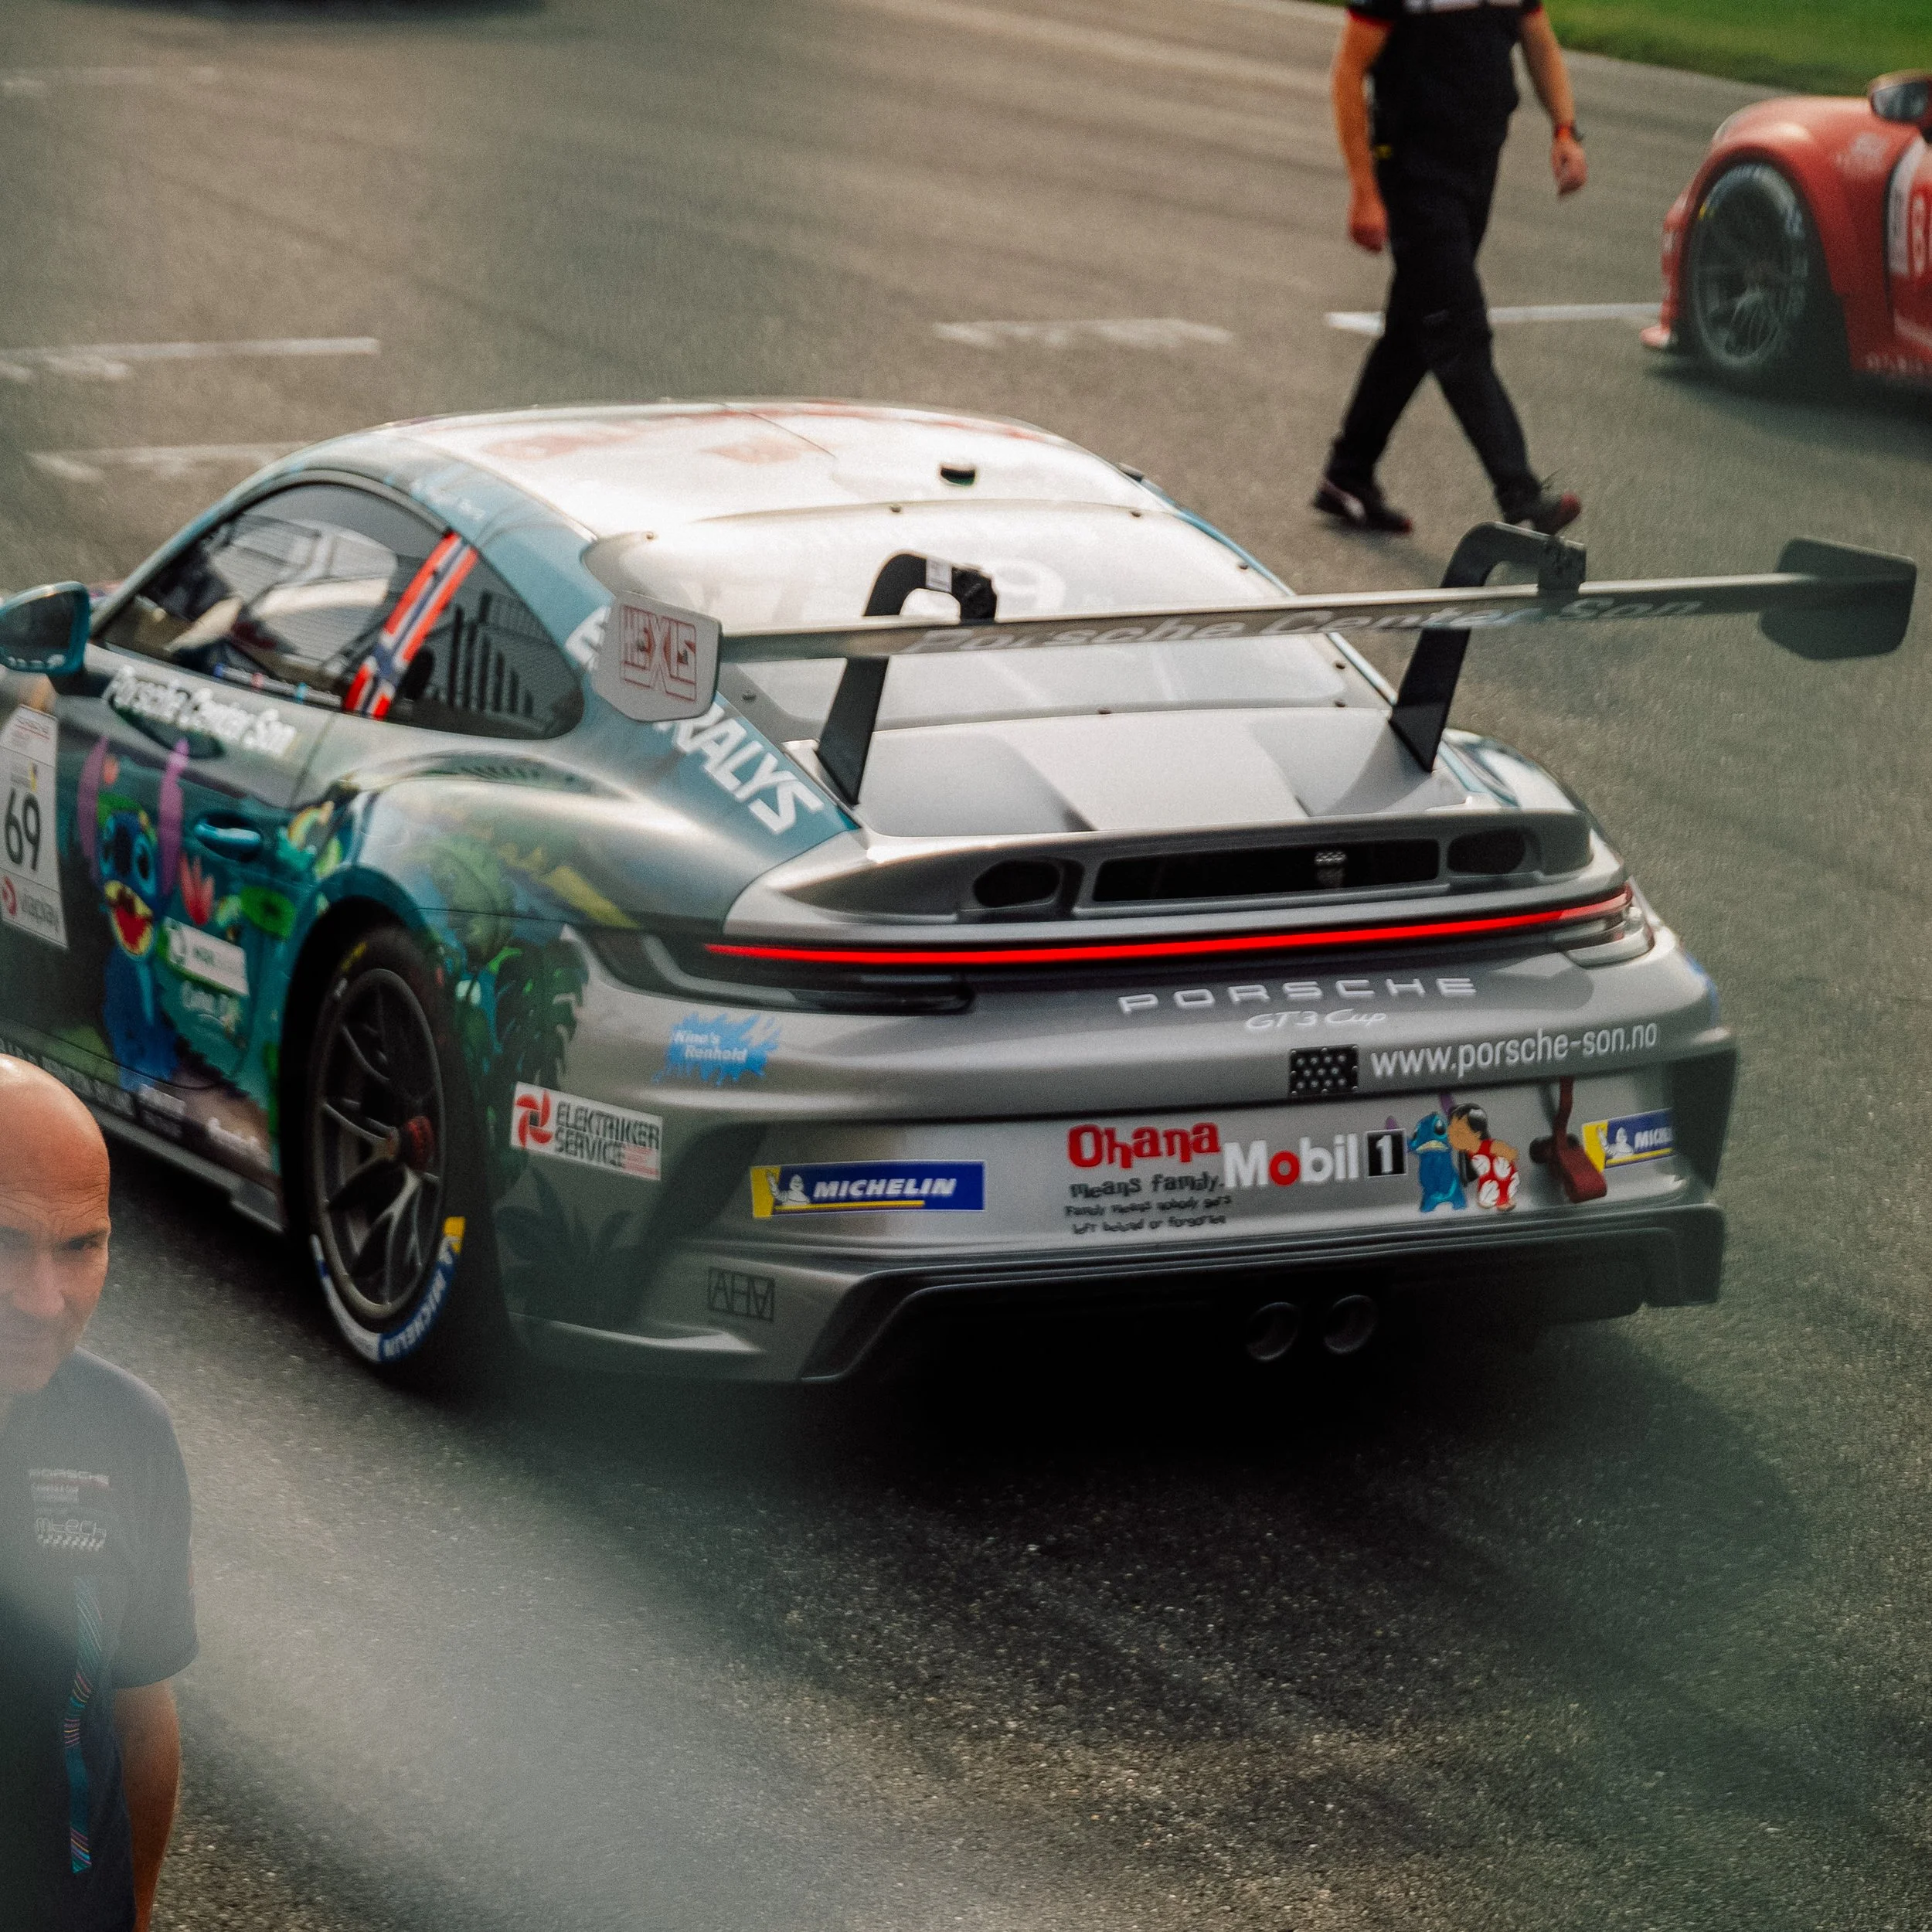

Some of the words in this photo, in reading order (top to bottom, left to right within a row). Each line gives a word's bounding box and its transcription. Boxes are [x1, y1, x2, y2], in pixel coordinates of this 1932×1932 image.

[904, 618, 1244, 654] Porsche
[1258, 607, 1544, 635] Center
[1560, 597, 1703, 619] Son
[4, 787, 41, 872] 69
[1117, 978, 1477, 1014] PORSCHE
[1245, 1010, 1317, 1030] GT3
[1324, 1008, 1387, 1026] Cup
[1371, 1022, 1658, 1080] www.porsche-son.no
[554, 1125, 624, 1168] SERVICE
[556, 1100, 660, 1151] ELEKTRIKER
[1066, 1121, 1222, 1169] Ohana
[1223, 1133, 1360, 1189] Mobil
[1375, 1134, 1394, 1175] 1
[813, 1177, 957, 1199] MICHELIN
